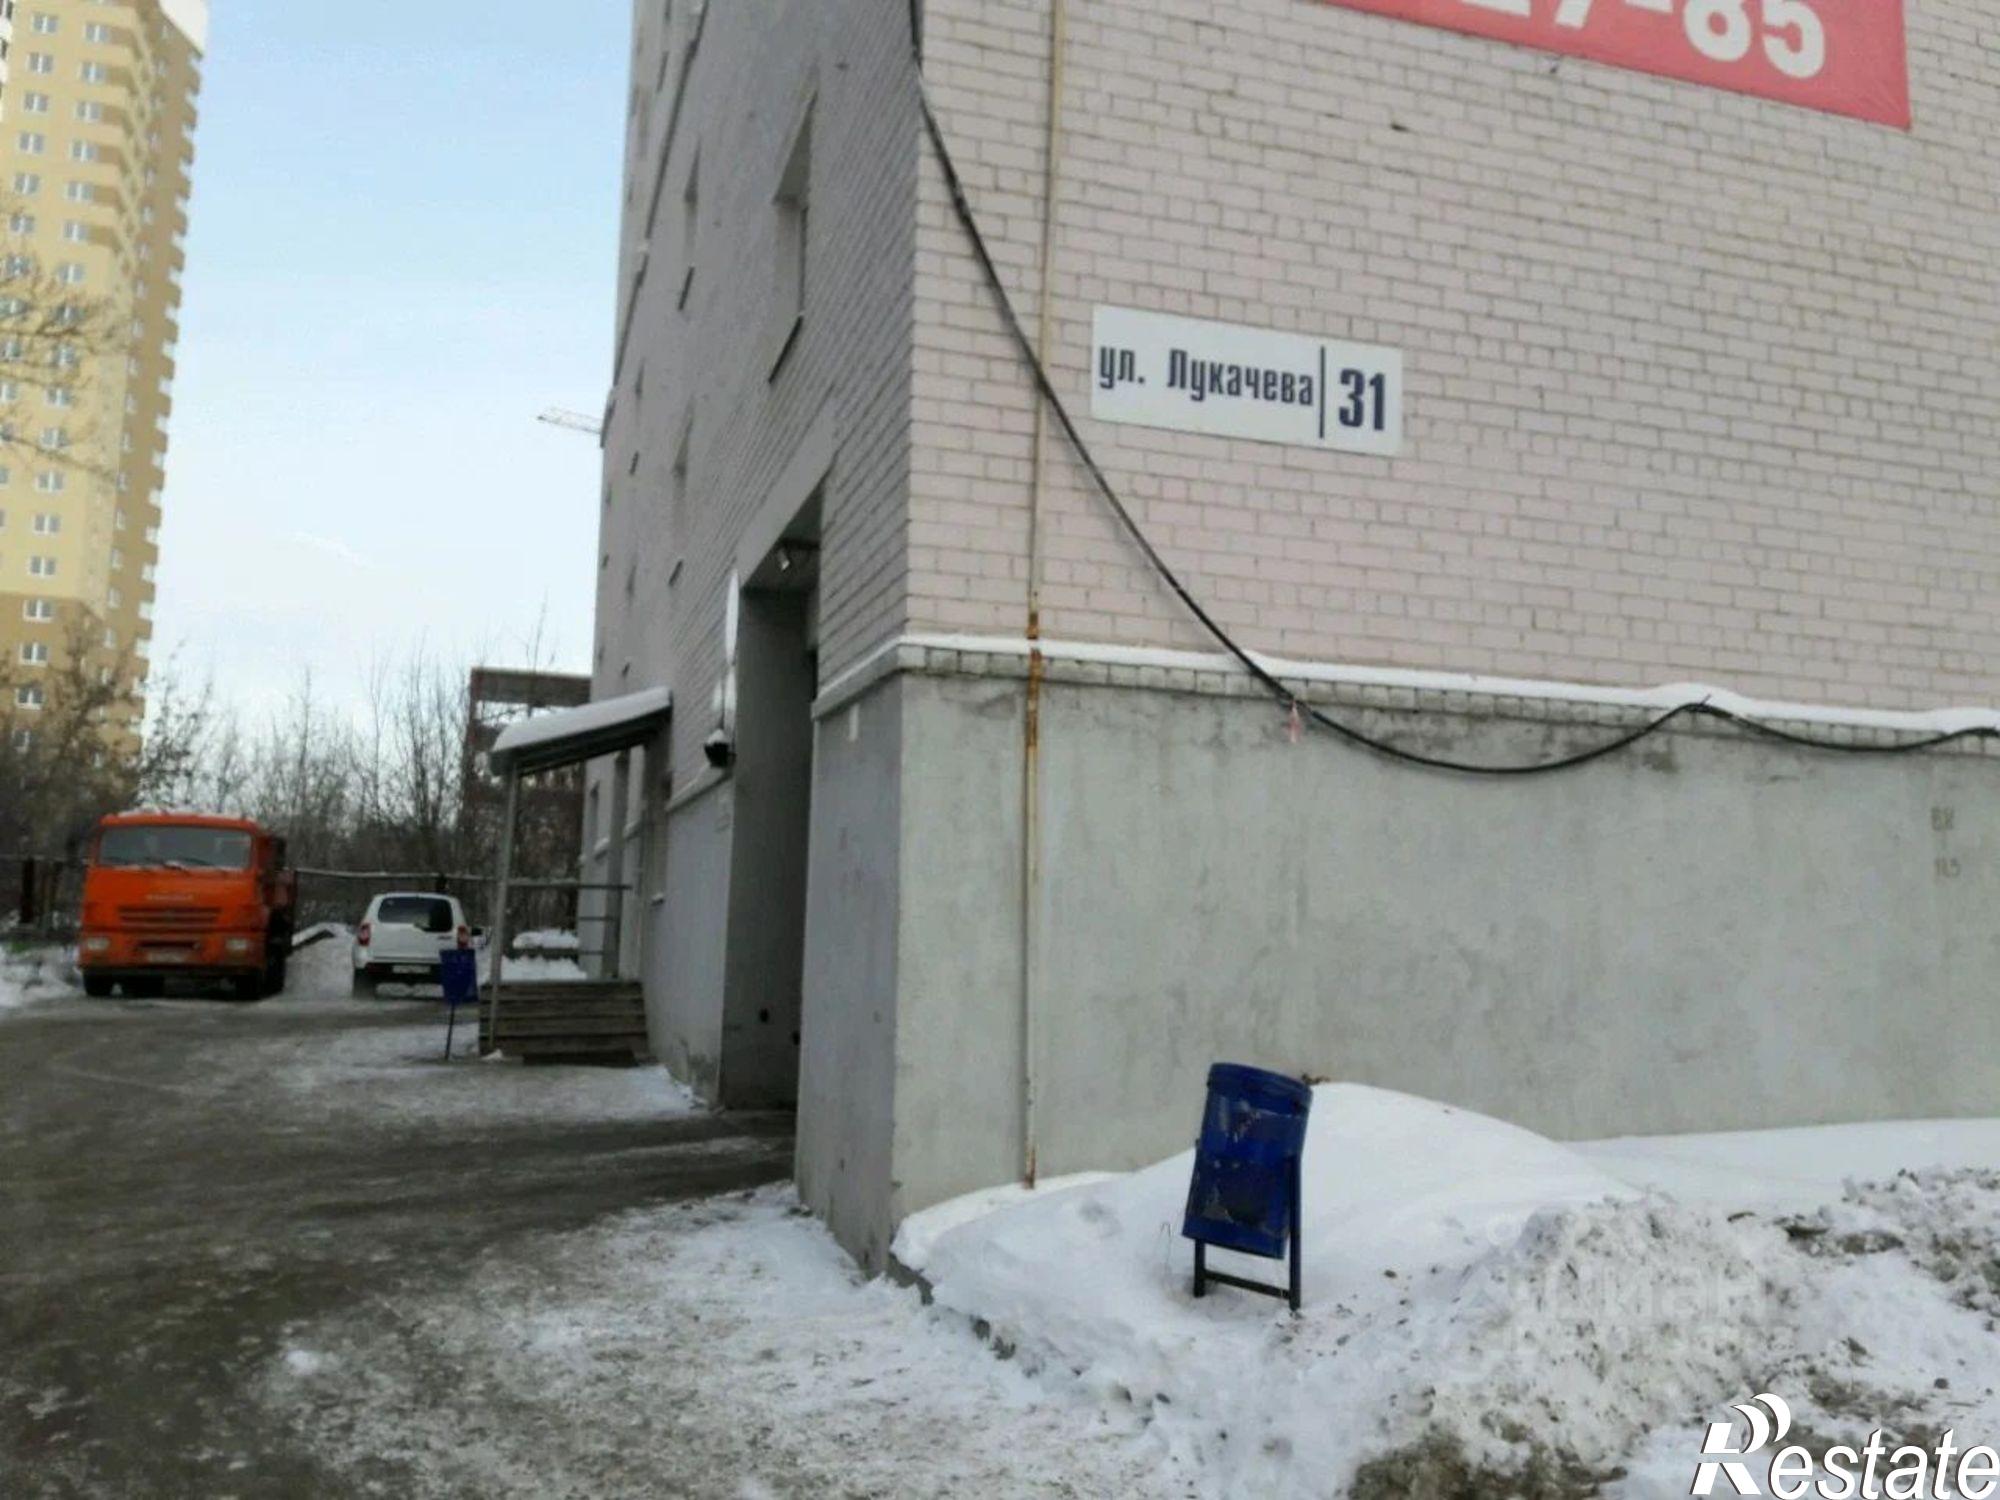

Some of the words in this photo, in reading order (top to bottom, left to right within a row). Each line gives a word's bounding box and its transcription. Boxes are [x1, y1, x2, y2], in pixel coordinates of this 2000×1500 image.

[1099, 346, 1146, 390] ул.
[1167, 348, 1314, 406] Лукачева
[1339, 367, 1386, 431] 31
